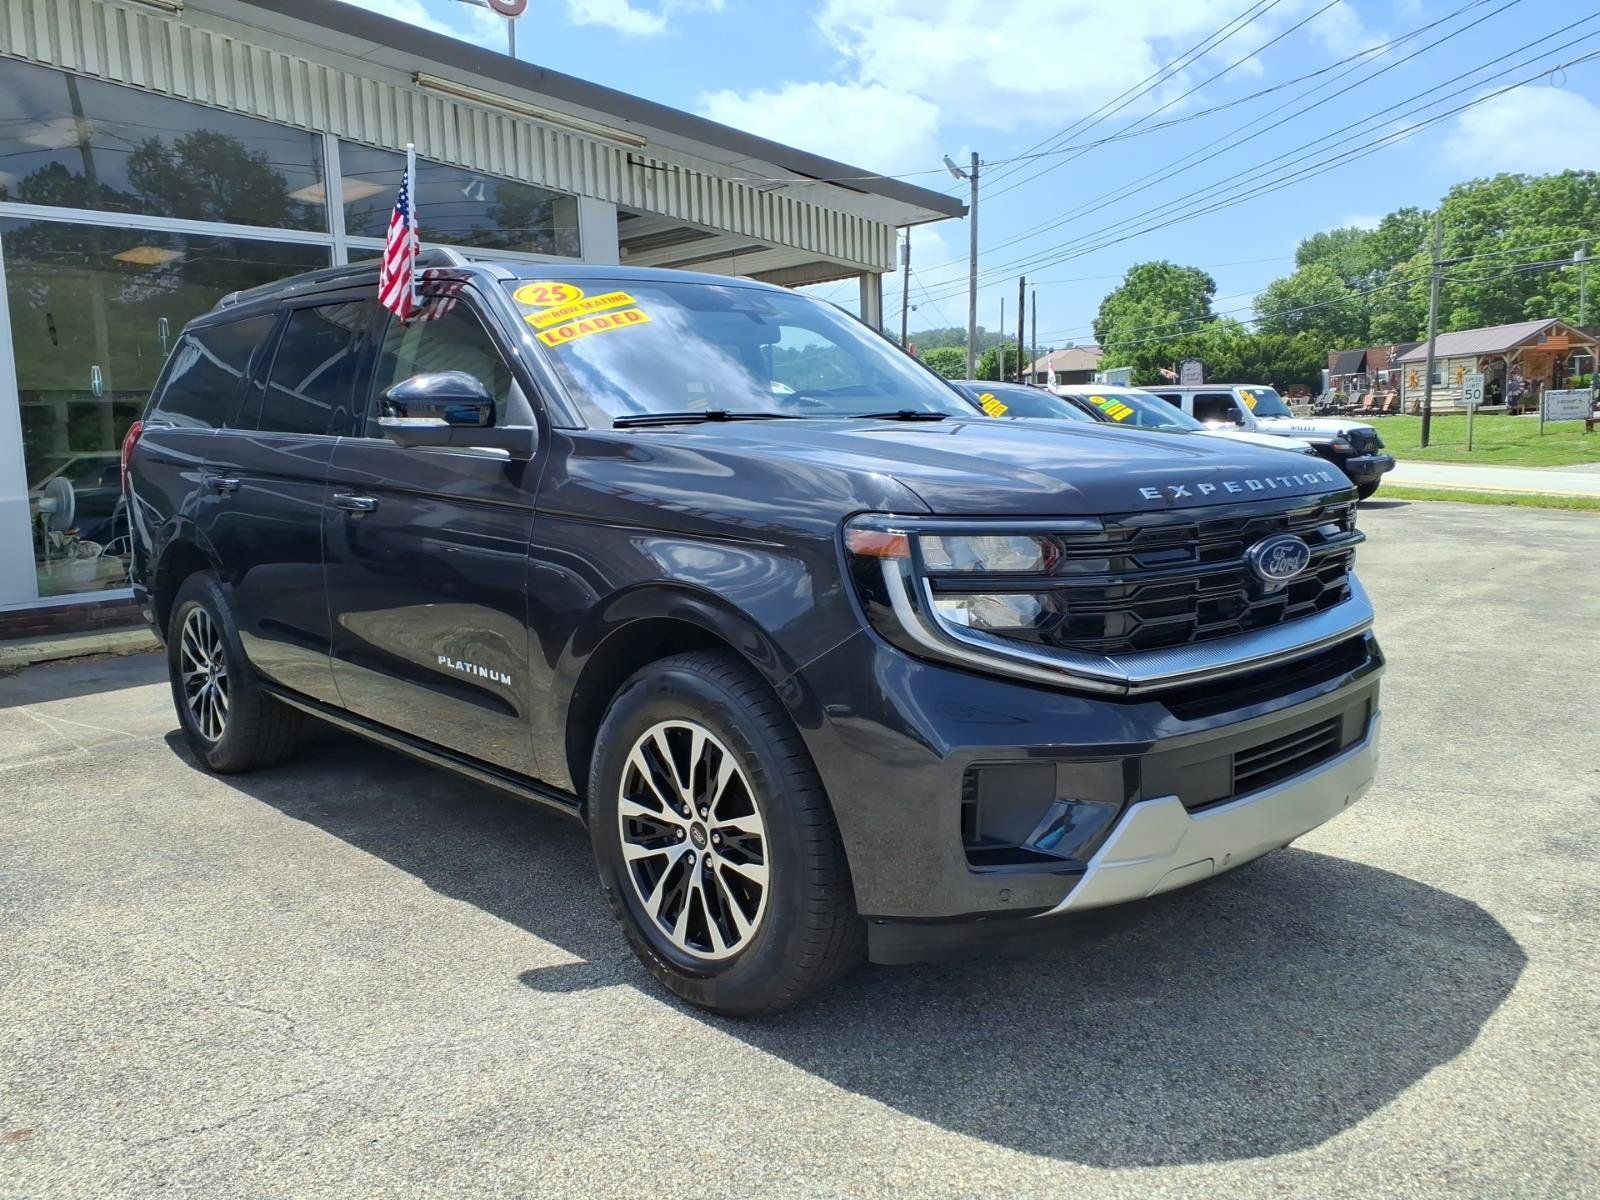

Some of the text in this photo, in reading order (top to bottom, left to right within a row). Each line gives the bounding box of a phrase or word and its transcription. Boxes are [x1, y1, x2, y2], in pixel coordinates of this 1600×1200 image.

[532, 285, 567, 303] 25
[551, 305, 578, 318] ROW
[579, 294, 629, 310] SEATING
[544, 311, 640, 344] LOADED
[1464, 389, 1481, 400] 50
[1139, 471, 1334, 500] EXPEDITION
[1269, 546, 1302, 574] Ford
[438, 655, 512, 686] PLATINUM
